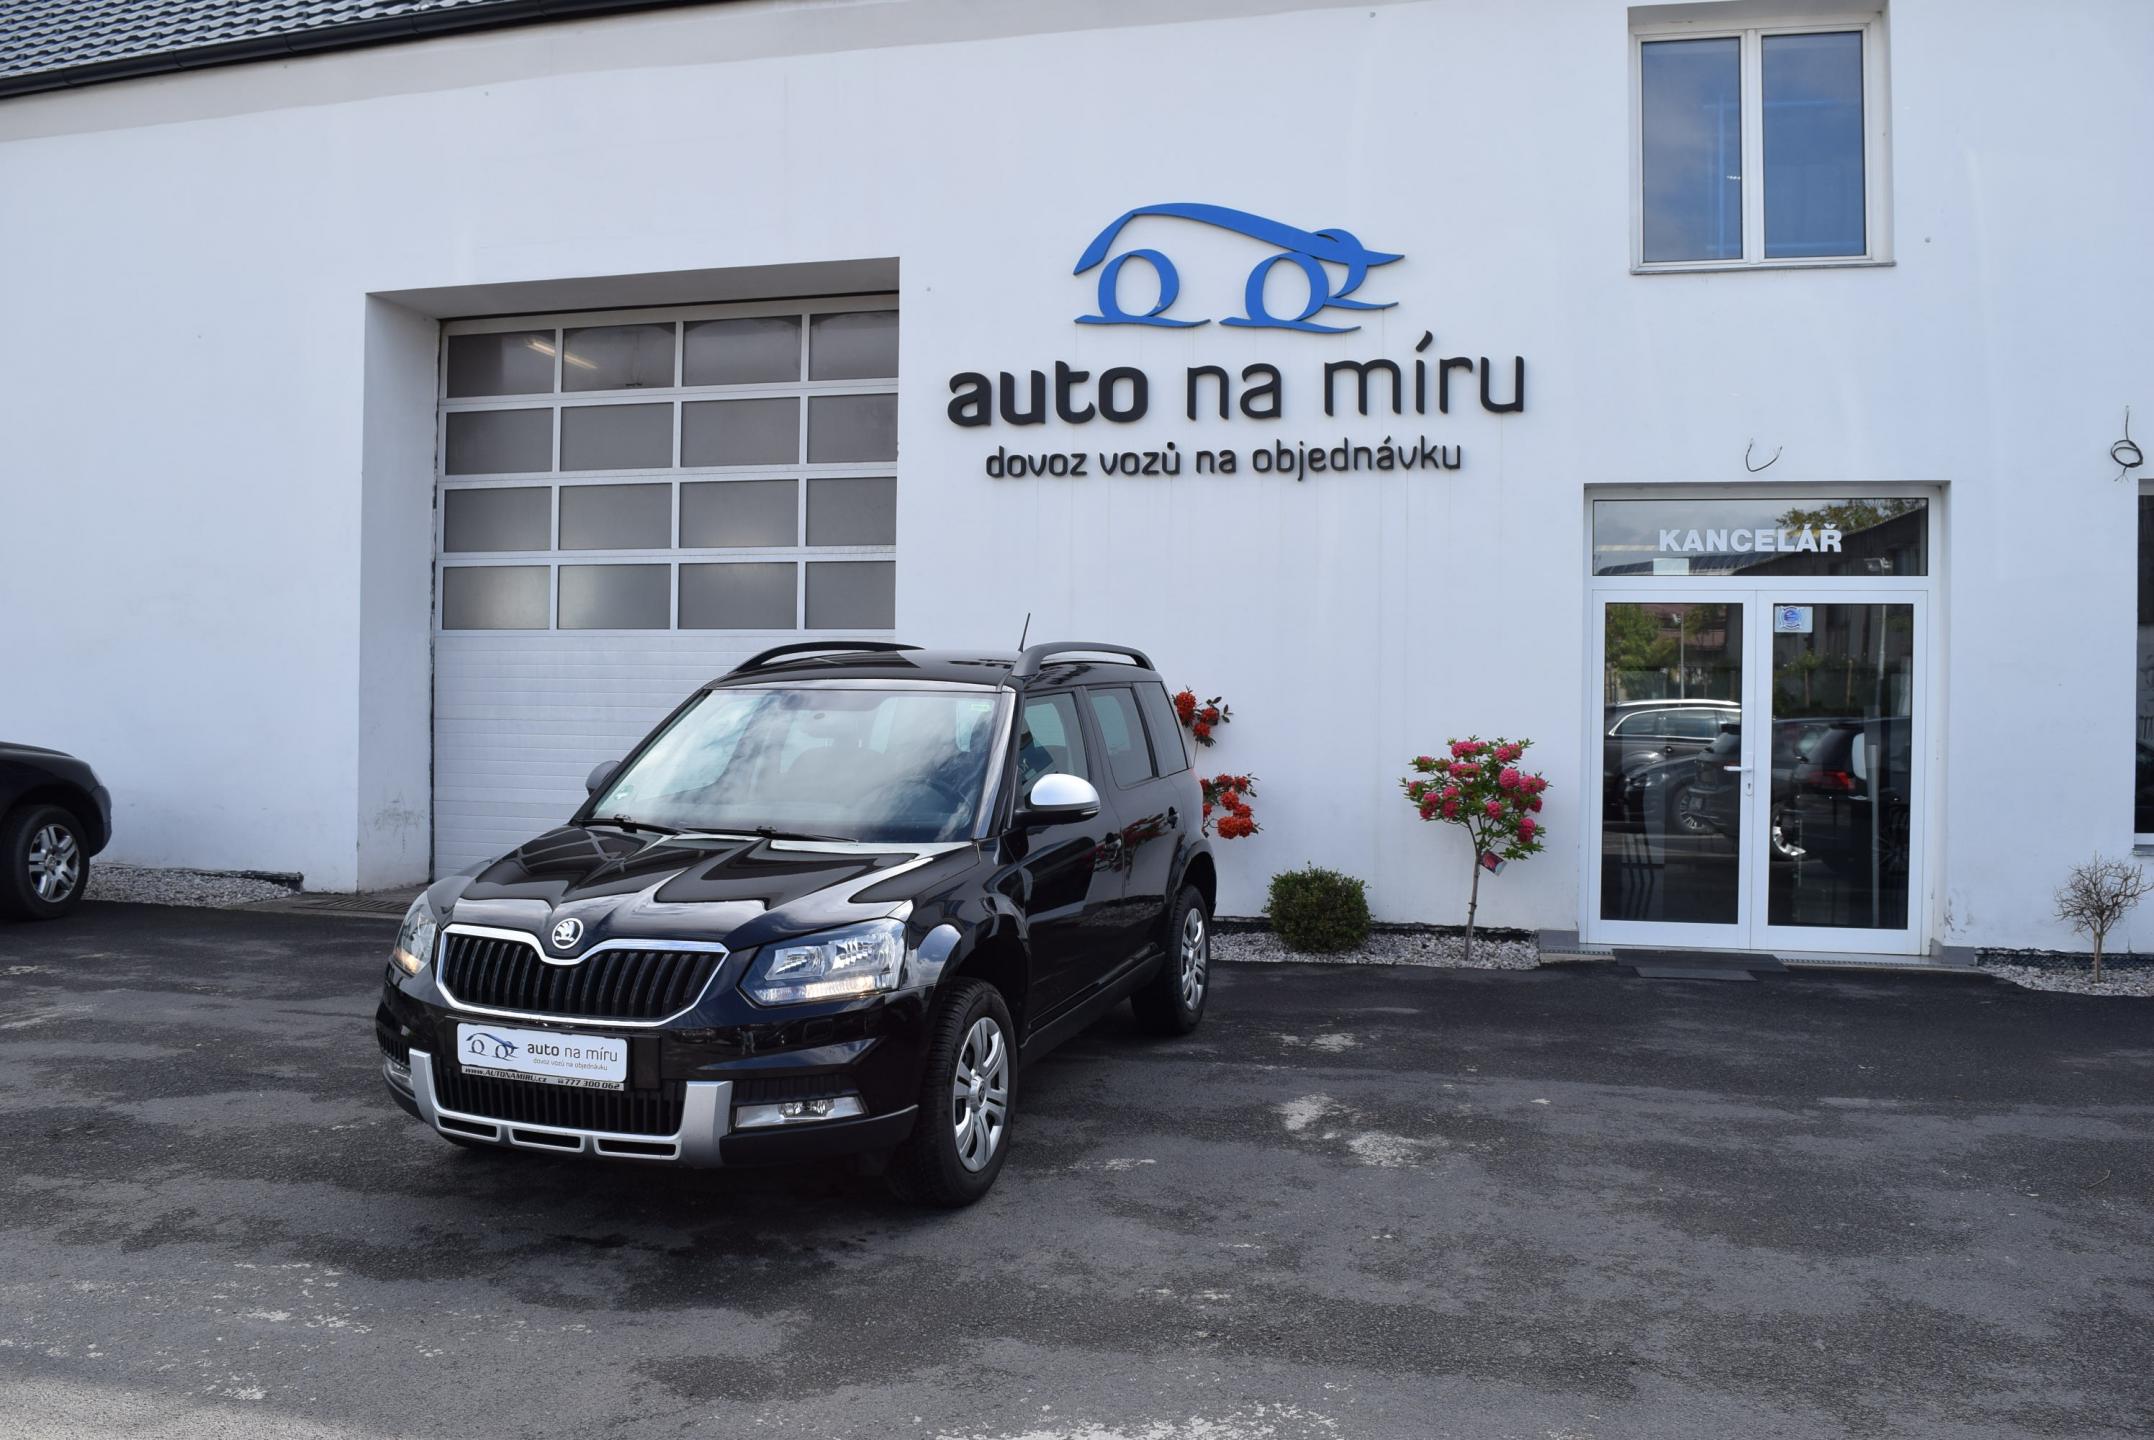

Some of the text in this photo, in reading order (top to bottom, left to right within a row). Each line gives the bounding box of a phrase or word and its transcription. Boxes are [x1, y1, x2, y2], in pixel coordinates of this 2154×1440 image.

[947, 330, 1525, 428] auto na míru
[985, 435, 1462, 482] dovoz vozů na objednávku
[1658, 524, 1842, 552] KANCELÁŘ
[527, 1043, 618, 1062] auto na míru
